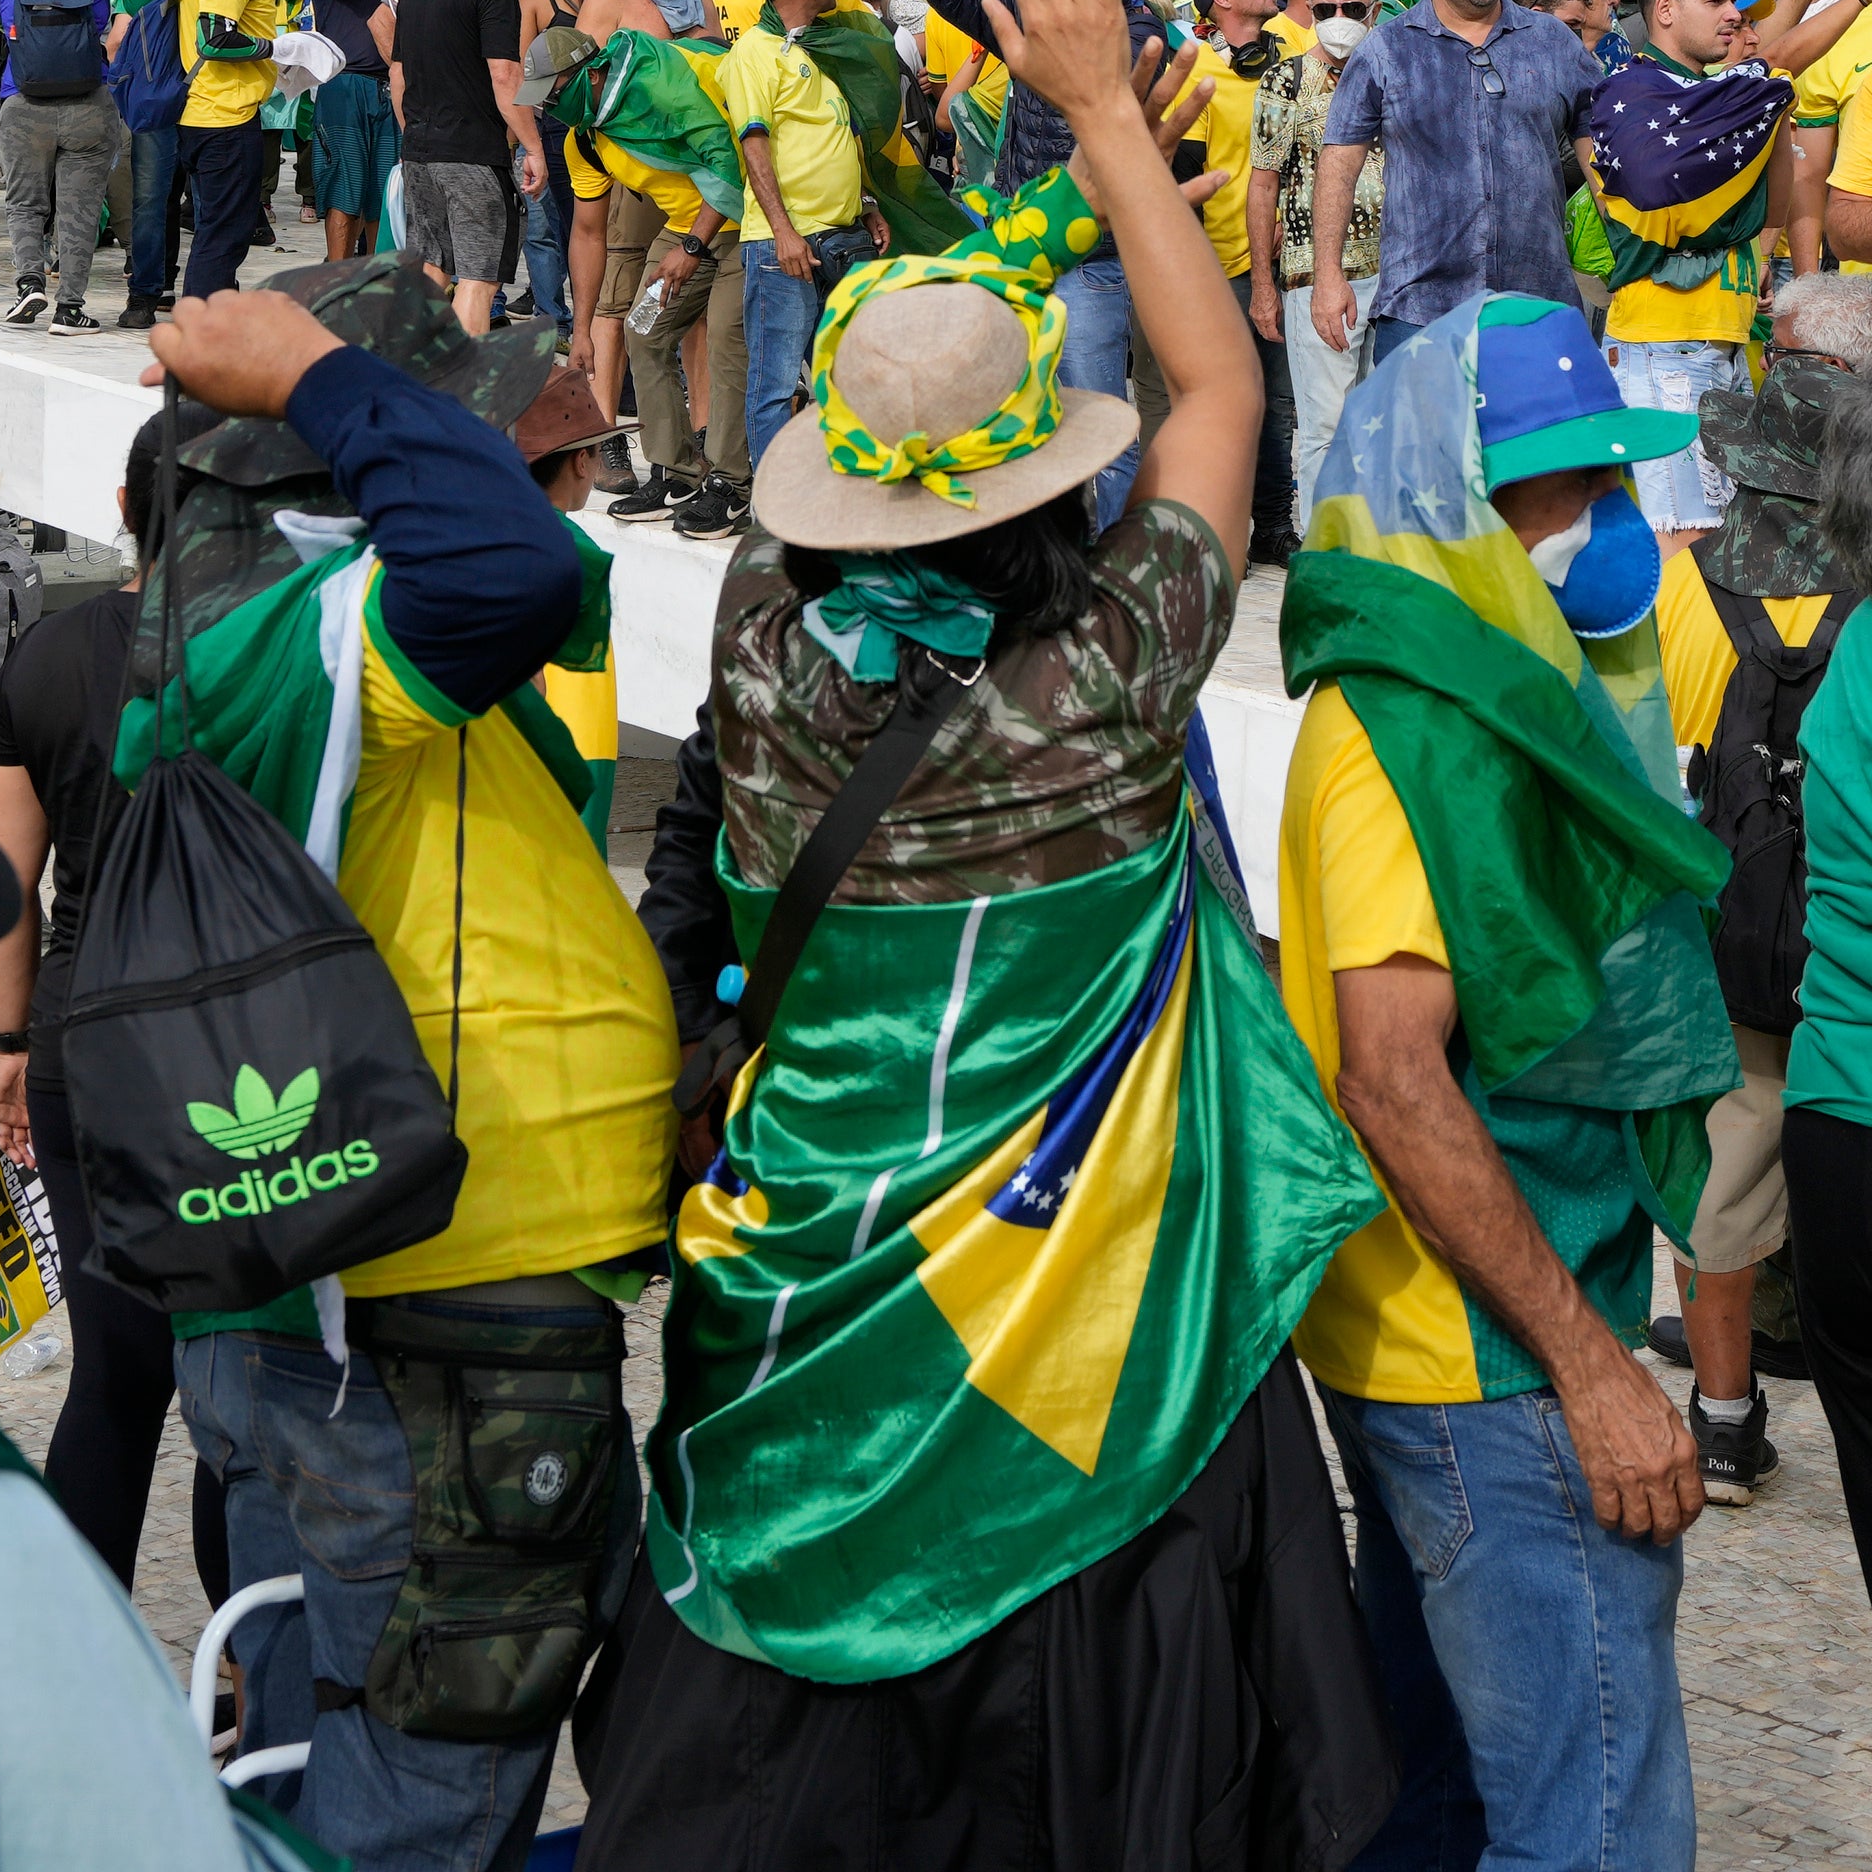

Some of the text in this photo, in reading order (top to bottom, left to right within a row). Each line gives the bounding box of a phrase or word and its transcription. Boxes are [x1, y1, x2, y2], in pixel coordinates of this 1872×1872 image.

[178, 1139, 380, 1225] adidas
[0, 1153, 38, 1238] ESCUTAM
[38, 1254, 62, 1307] POVO
[1708, 1457, 1736, 1472] Polo
